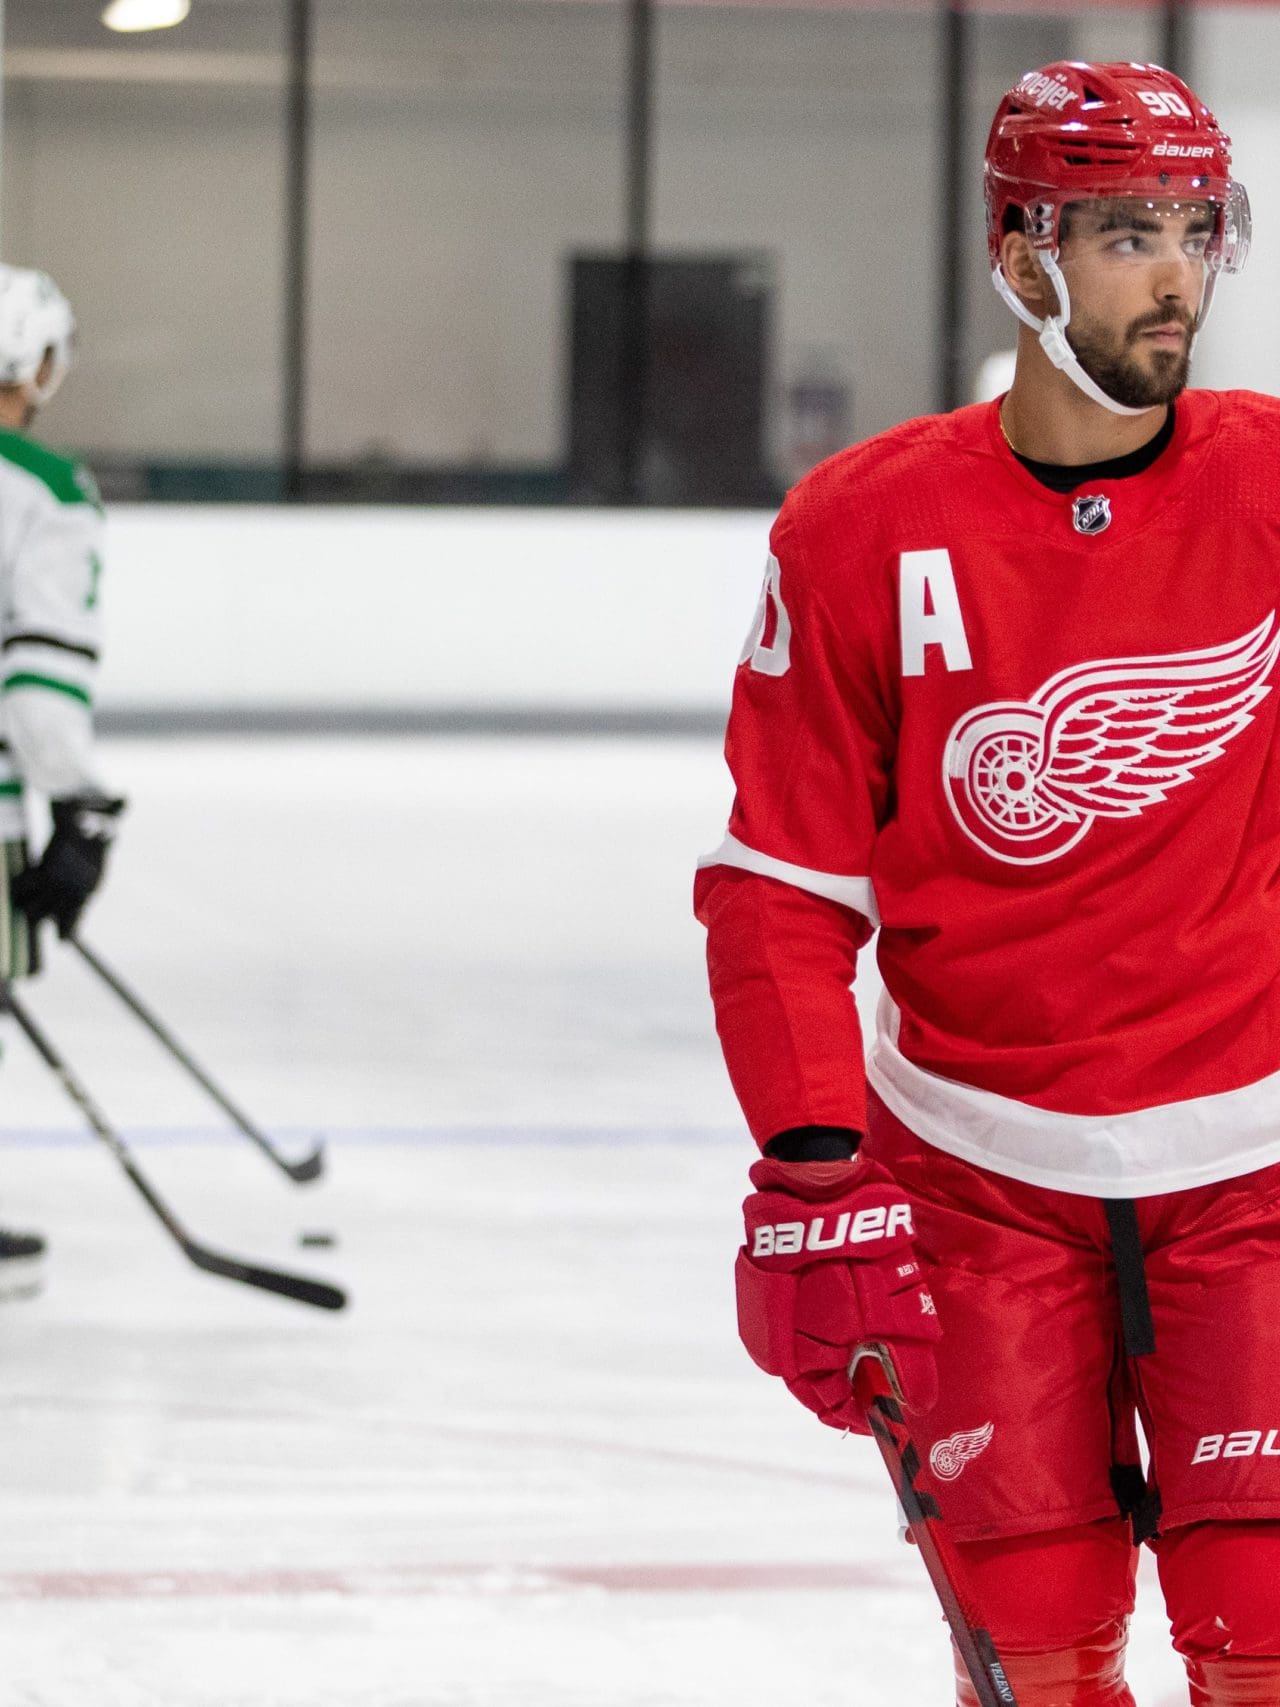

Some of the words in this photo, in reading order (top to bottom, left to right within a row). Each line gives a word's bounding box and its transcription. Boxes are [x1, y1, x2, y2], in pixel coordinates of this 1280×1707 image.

[1136, 91, 1192, 117] 90
[900, 548, 973, 678] A
[989, 1662, 1014, 1702] VELENO
